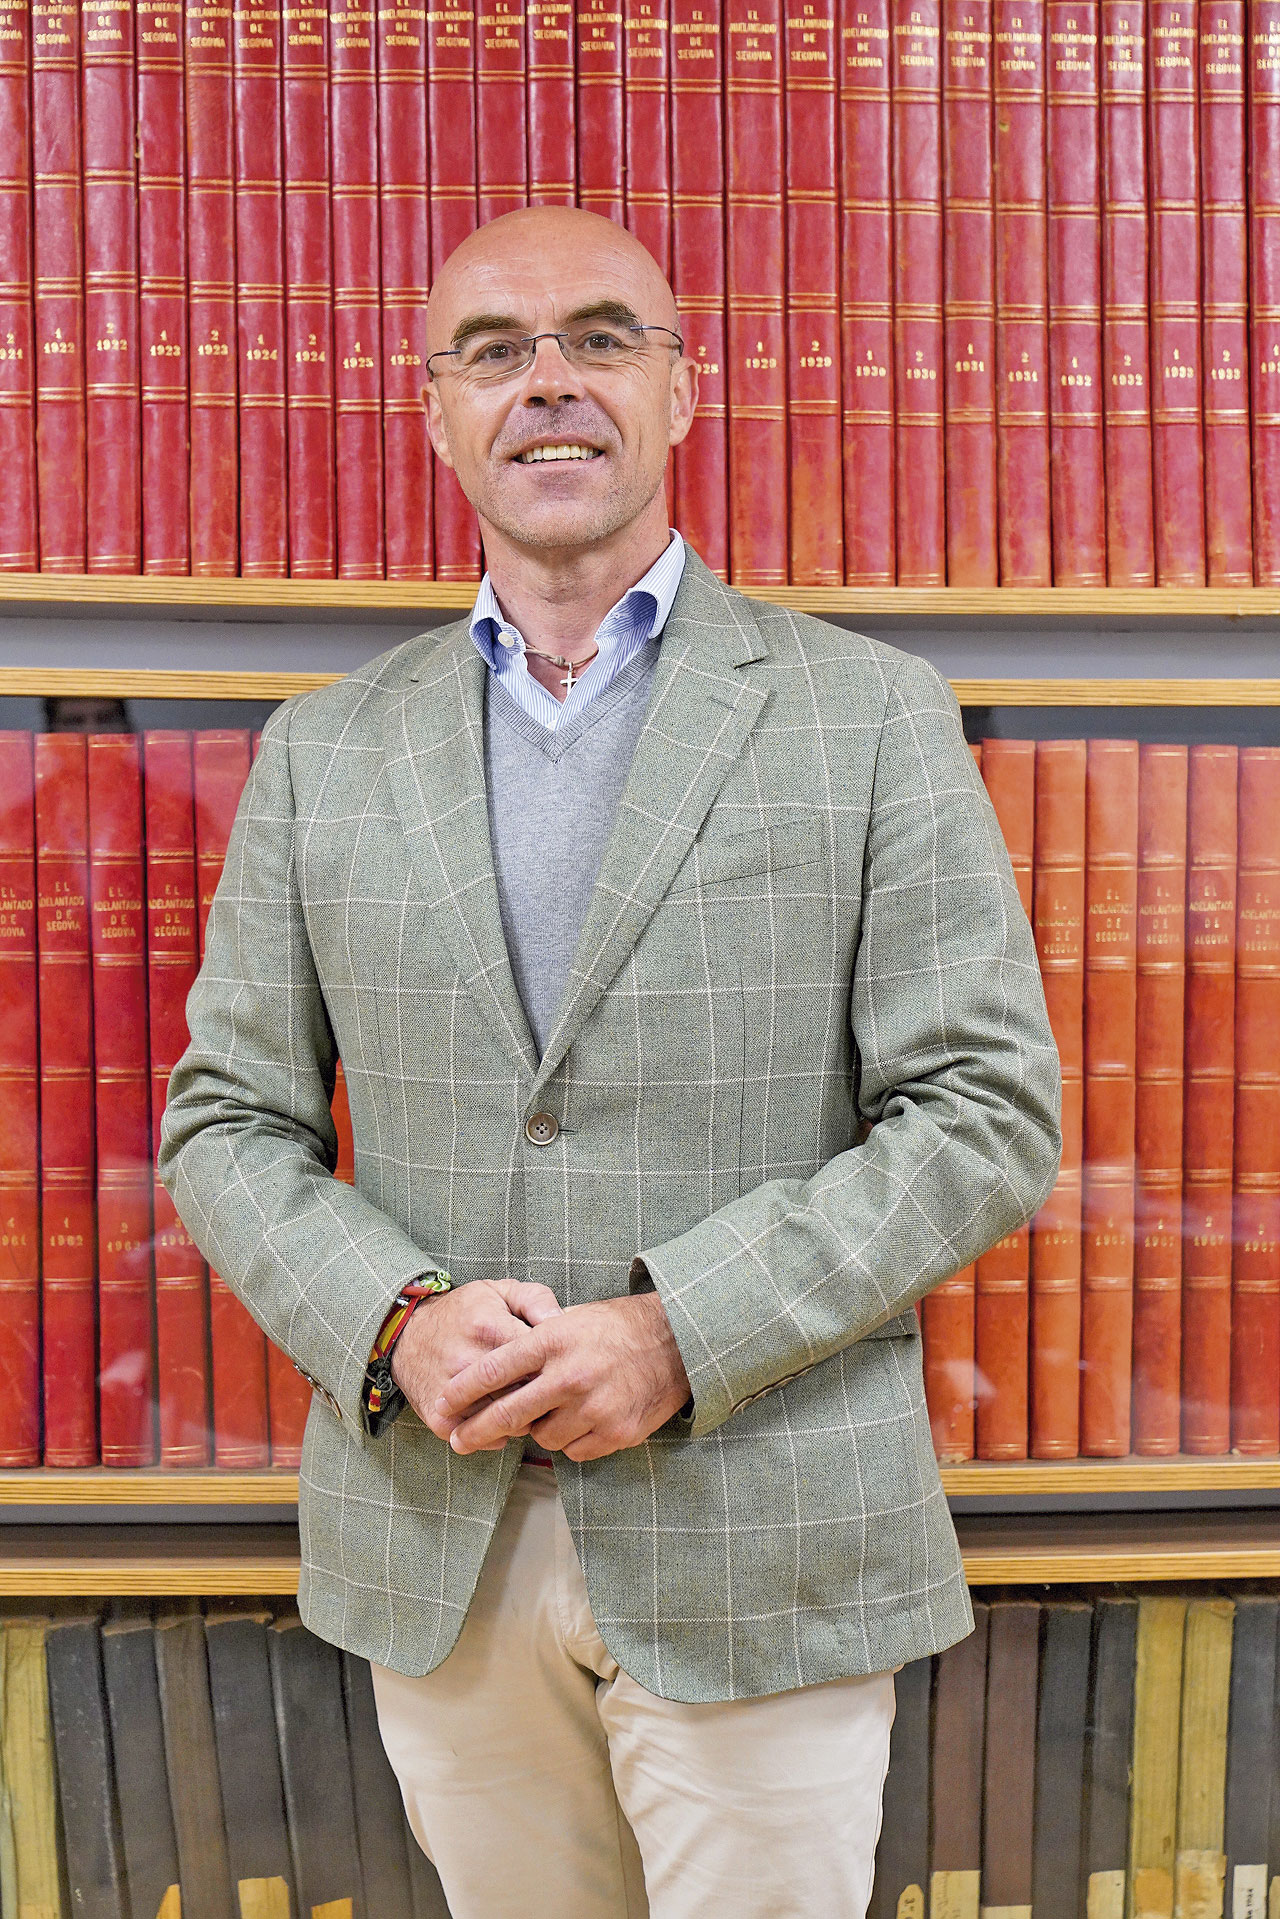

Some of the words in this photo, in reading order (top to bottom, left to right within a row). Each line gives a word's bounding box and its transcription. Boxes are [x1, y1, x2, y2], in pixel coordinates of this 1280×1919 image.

[55, 328, 62, 339] 1
[106, 323, 114, 333] 2
[7, 333, 14, 344] 2
[160, 330, 167, 341] 1
[211, 330, 219, 341] 2
[257, 334, 264, 344] 1
[308, 334, 317, 345] 2
[44, 342, 75, 354] 1922
[97, 339, 127, 351] 1922
[354, 342, 361, 352] 1
[401, 338, 409, 349] 2
[757, 341, 763, 352] 1
[812, 340, 820, 351] 2
[968, 343, 973, 354] 1
[0, 348, 23, 360] 921
[150, 345, 181, 356] 1923
[198, 344, 229, 355] 1923
[246, 349, 278, 360] 1924
[698, 345, 707, 356] 2
[866, 350, 872, 360] 1
[1173, 348, 1179, 360] 1
[1273, 344, 1279, 356] 1
[295, 351, 326, 362] 1924
[390, 354, 421, 365] 1925
[915, 350, 923, 362] 2
[1021, 352, 1029, 363] 2
[1124, 354, 1131, 366] 2
[1223, 350, 1230, 362] 2
[343, 357, 374, 369] 1925
[746, 358, 776, 368] 1929
[801, 357, 832, 367] 1929
[955, 360, 984, 372] 1931
[1072, 357, 1078, 368] 1
[697, 363, 719, 374] 928
[856, 366, 886, 376] 1930
[906, 368, 936, 379] 1930
[1165, 366, 1194, 378] 1933
[1211, 368, 1240, 379] 1933
[1008, 371, 1038, 382] 1931
[1061, 375, 1091, 386] 1932
[1112, 374, 1143, 386] 1932
